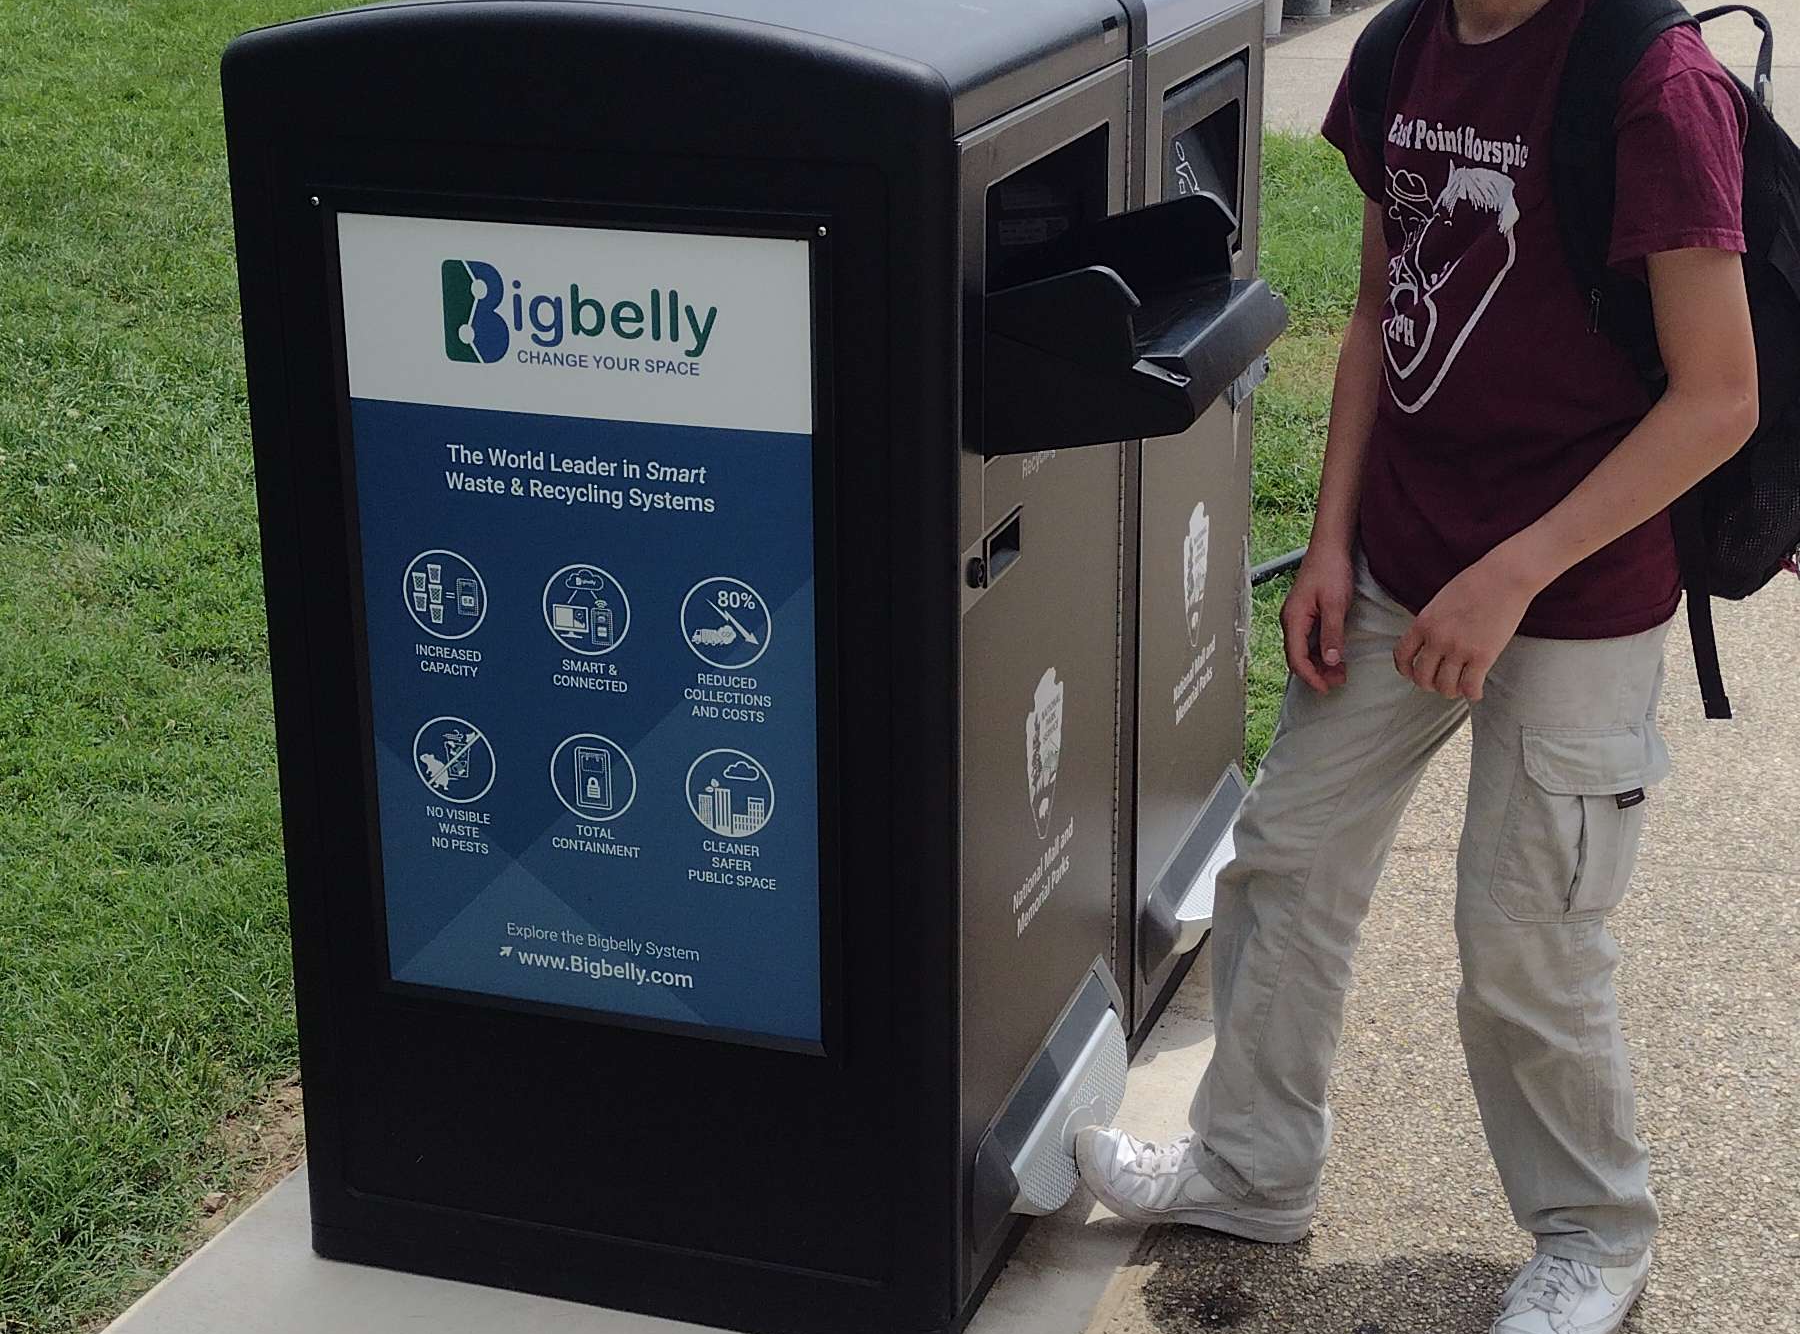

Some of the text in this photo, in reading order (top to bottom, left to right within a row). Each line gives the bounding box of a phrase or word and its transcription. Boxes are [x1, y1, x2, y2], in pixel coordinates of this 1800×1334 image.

[1415, 118, 1463, 156] Point
[441, 259, 718, 364] Bigbelly
[518, 350, 701, 377] CHANGE YOUR SPACE
[446, 443, 707, 484] The World Leader in Smart
[446, 471, 716, 513] Waste & Recycling Systems
[717, 590, 756, 610] 80%
[415, 643, 482, 663] INCREASED
[420, 660, 478, 678] CAPACITY
[562, 659, 618, 676] SMART &
[553, 674, 628, 694] CONNECTED
[697, 673, 757, 690] REDUCED
[684, 687, 772, 708] COLLECTIONS
[691, 704, 765, 723] AND COSTS
[426, 805, 491, 825] NO VISIBLE
[438, 822, 480, 838] WASTE
[576, 824, 615, 840] TOTAL
[431, 836, 489, 855] NO PESTS
[552, 836, 640, 859] CONTAINMENT
[702, 839, 760, 857] CLEANER
[712, 856, 752, 872] SAFER
[1012, 816, 1074, 914] National Mall and
[688, 869, 777, 890] PUBLIC SPACE
[1016, 855, 1071, 939] Memorial Parks
[507, 922, 700, 962] Explore the Bigbelly System
[518, 950, 694, 989] www.Bigbelly.com
